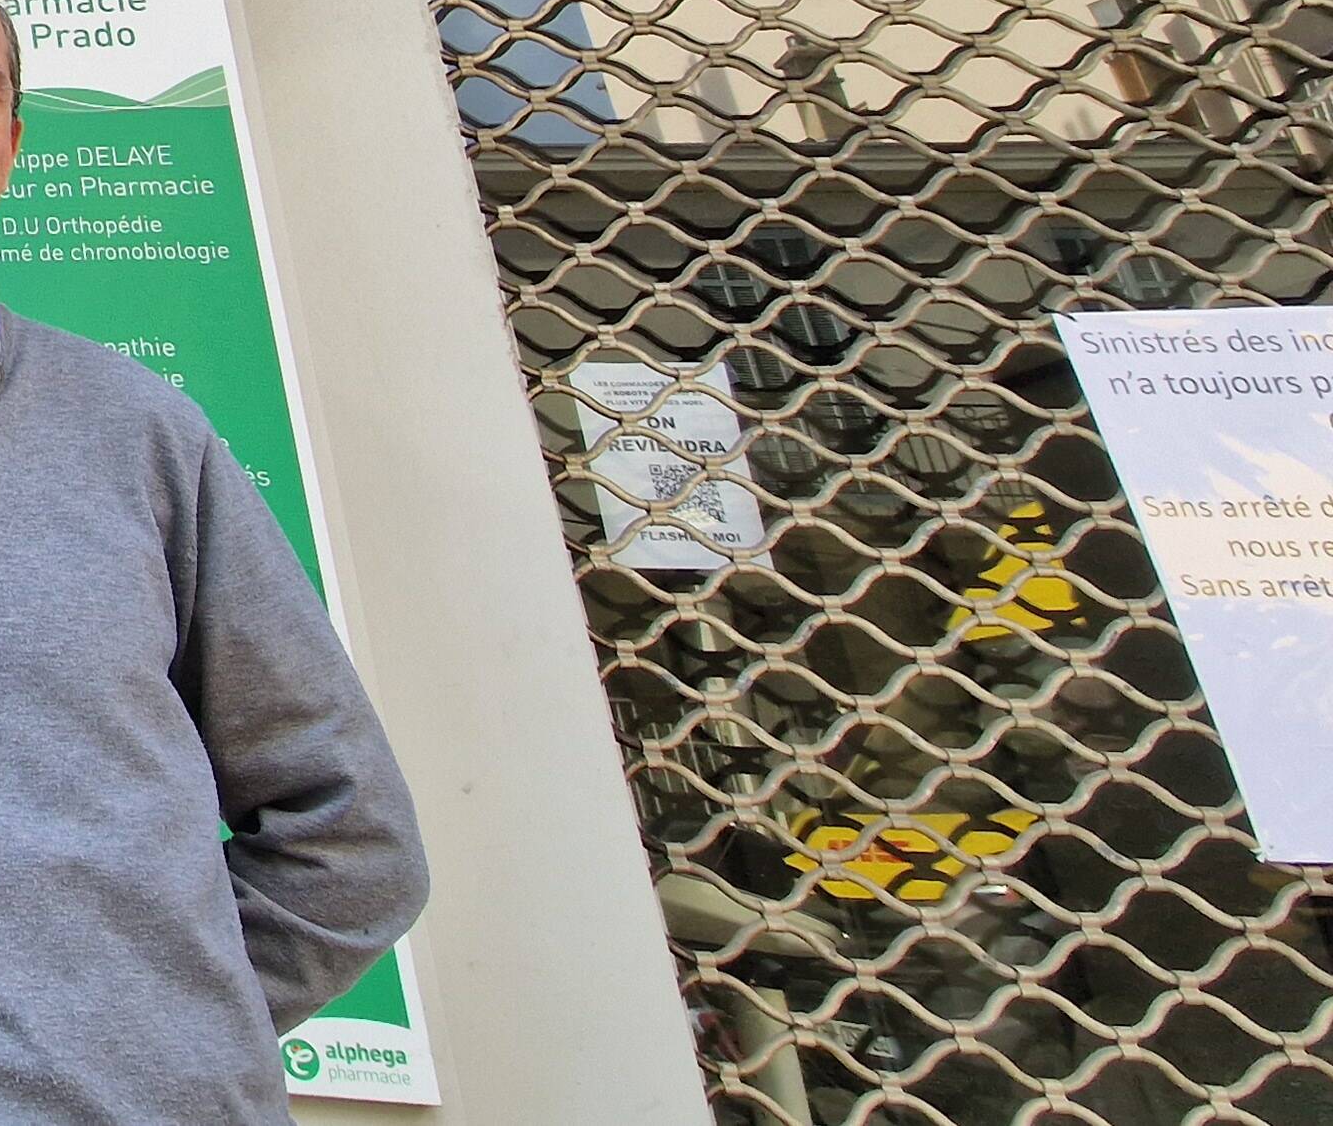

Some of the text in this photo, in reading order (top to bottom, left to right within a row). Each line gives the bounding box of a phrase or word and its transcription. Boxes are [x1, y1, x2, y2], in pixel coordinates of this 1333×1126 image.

[30, 20, 137, 50] Prado
[13, 145, 174, 173] lippe DELAYE
[44, 181, 73, 198] en
[80, 175, 215, 197] Pharmacie
[2, 215, 163, 237] D.U Orthopédie
[39, 243, 65, 262] de
[70, 241, 231, 265] chronobiologie
[1080, 328, 1219, 355] Sinistrés
[1227, 328, 1284, 353] des
[1107, 370, 1157, 395] n'a
[1162, 370, 1304, 401] toujours
[646, 415, 677, 430] ON
[1142, 494, 1213, 519] Sans
[1222, 494, 1311, 519] arrêté
[713, 532, 742, 543] MOI
[1227, 538, 1302, 559] nous
[1179, 572, 1251, 597] Sans
[325, 1040, 408, 1068] alphega
[328, 1064, 411, 1085] pharmacie
